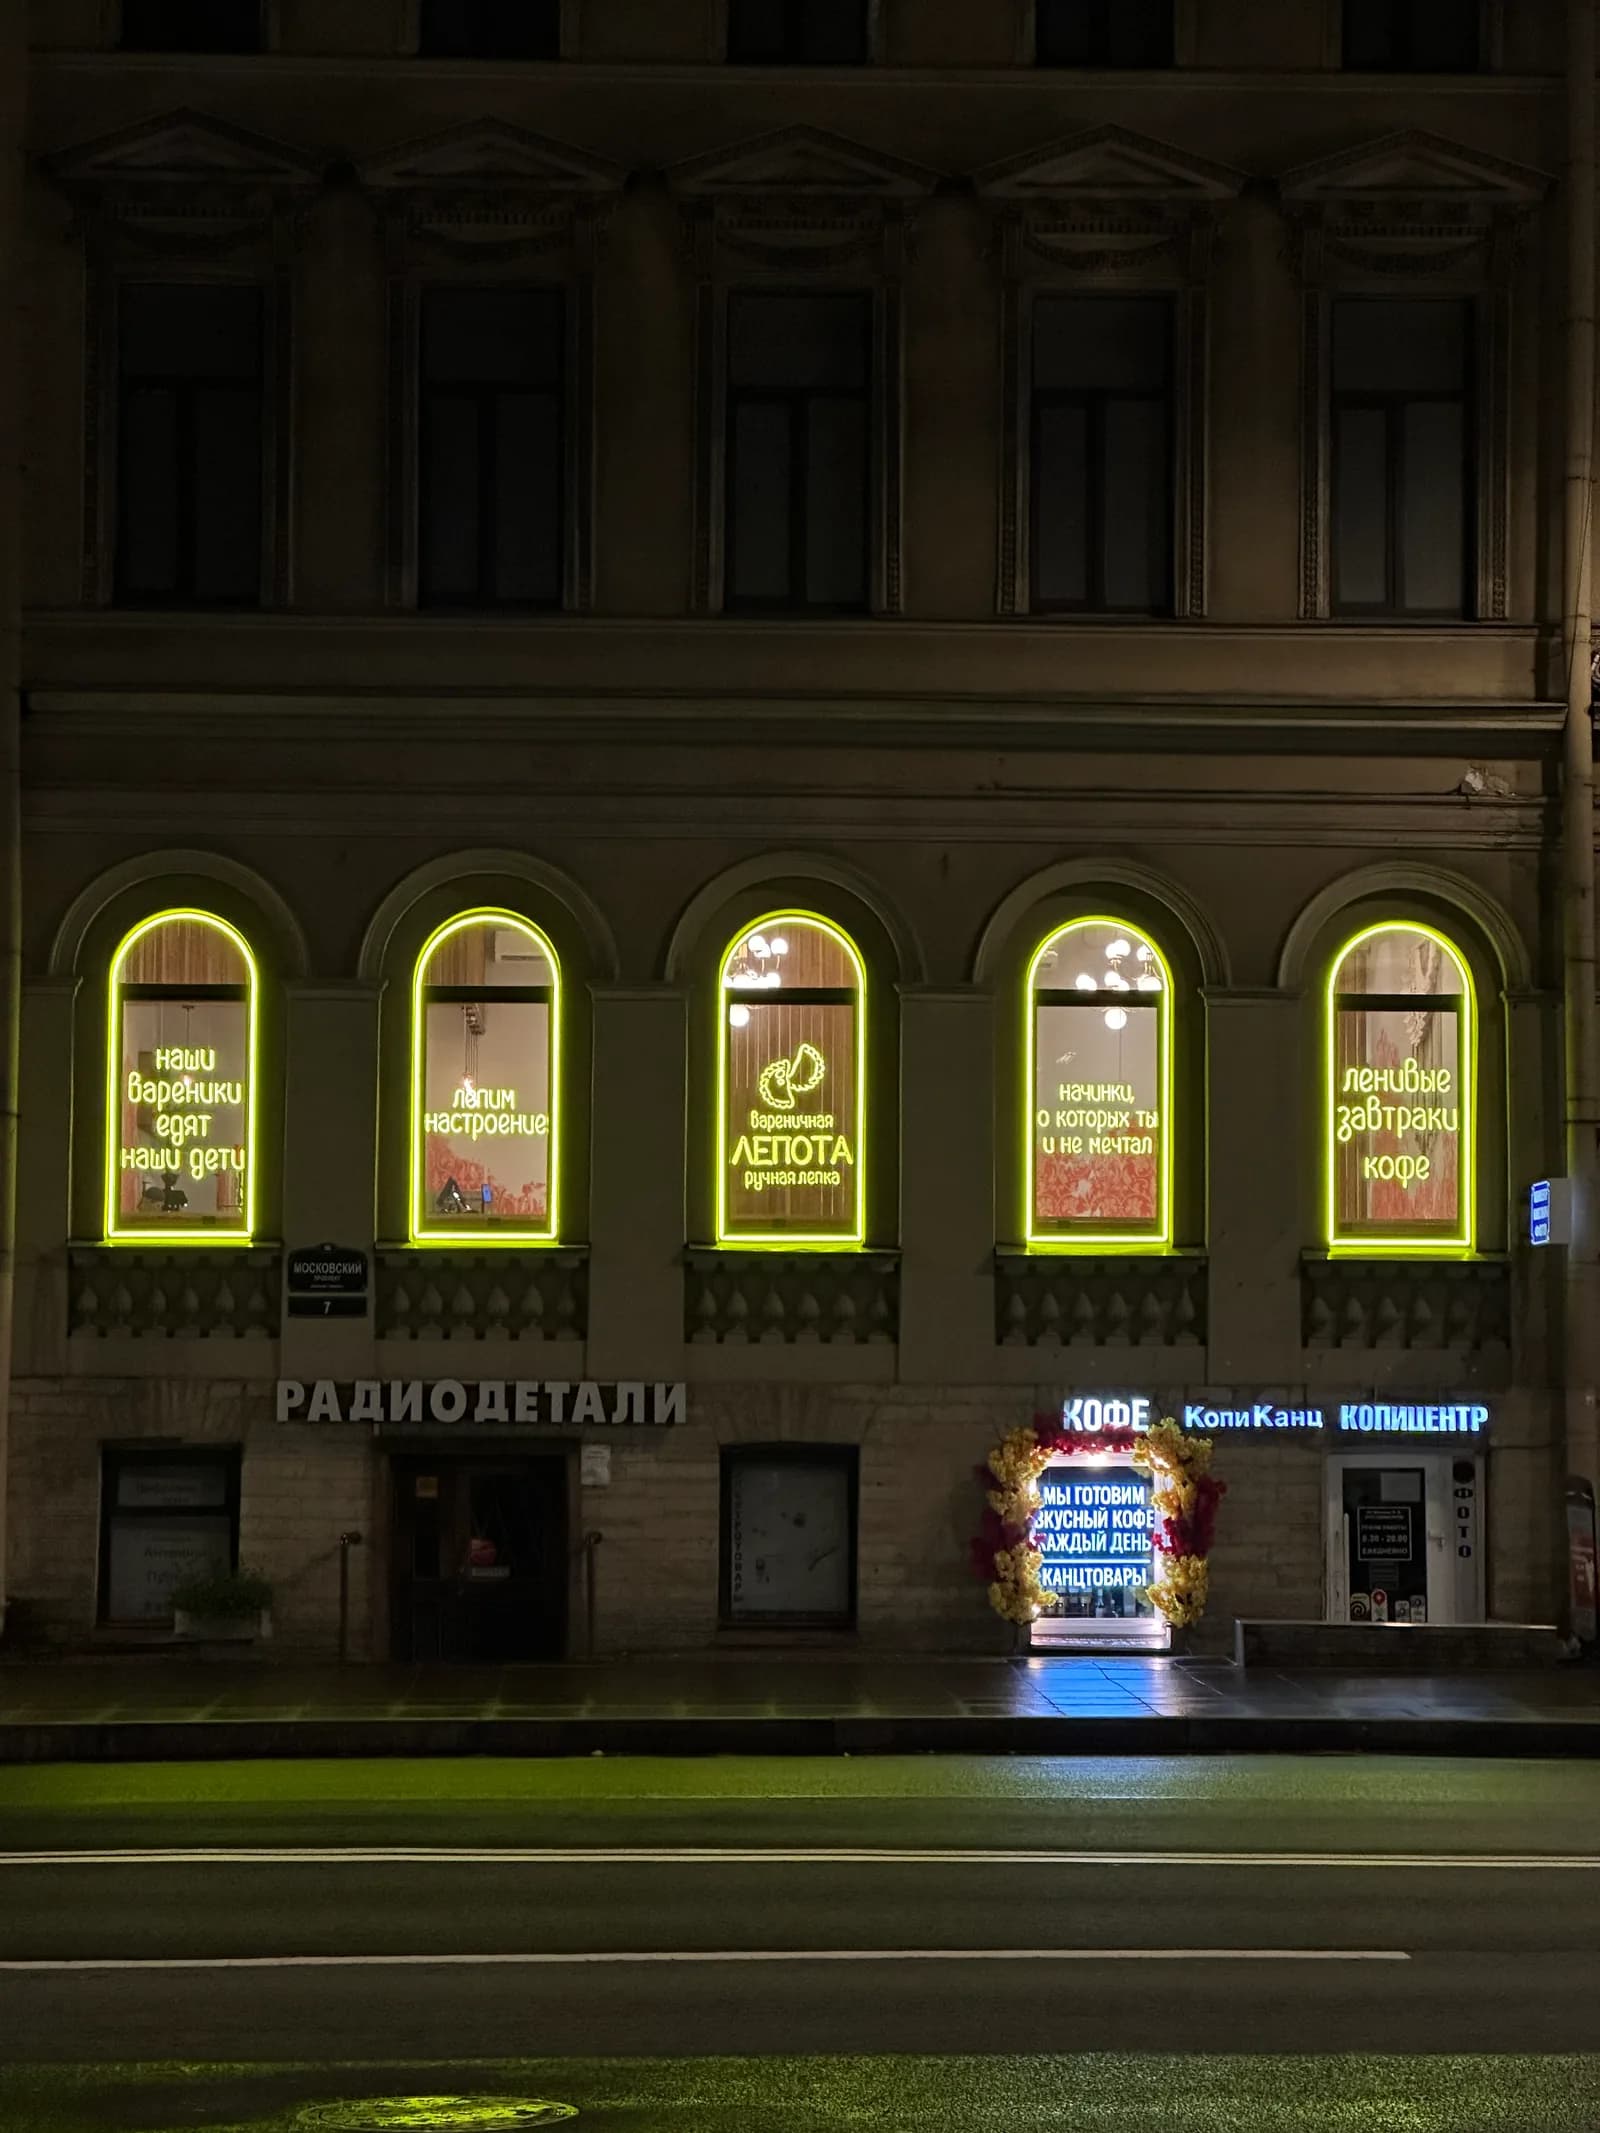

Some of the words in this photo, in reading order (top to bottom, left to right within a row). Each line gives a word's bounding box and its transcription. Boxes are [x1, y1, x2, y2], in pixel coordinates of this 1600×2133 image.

[155, 1047, 215, 1071] наши
[1342, 1057, 1451, 1093] ленивые
[127, 1071, 242, 1112] вареники
[1059, 1083, 1135, 1104] начинки,
[156, 1113, 212, 1147] едят
[424, 1112, 547, 1142] настроение
[750, 1109, 834, 1133] вареничная
[1037, 1109, 1050, 1128] о
[1056, 1109, 1130, 1134] которых
[1135, 1110, 1159, 1128] ты
[1336, 1095, 1458, 1142] завтраки
[731, 1135, 854, 1166] ЛЕПОТА
[1042, 1136, 1055, 1154] и
[1060, 1136, 1082, 1154] не
[1088, 1136, 1153, 1154] мечтал
[121, 1146, 181, 1170] наши
[189, 1147, 245, 1180] дети
[1363, 1154, 1430, 1189] кофе
[744, 1171, 797, 1191] ручная
[797, 1171, 840, 1186] лепка
[323, 1300, 332, 1315] 7
[275, 1380, 687, 1425] РАДИОДЕТАЛИ
[1062, 1398, 1150, 1432] КОФЕ
[1340, 1404, 1489, 1432] КОПИЦЕНТР
[1043, 1485, 1071, 1505] МЫ
[1075, 1485, 1145, 1505] ГОТОВИМ
[1112, 1509, 1155, 1529] КОФЕ
[1454, 1487, 1473, 1558] ФОТО
[1110, 1533, 1153, 1554] ДЕНЬ
[1042, 1567, 1147, 1589] КАНЦТОВАРЫ
